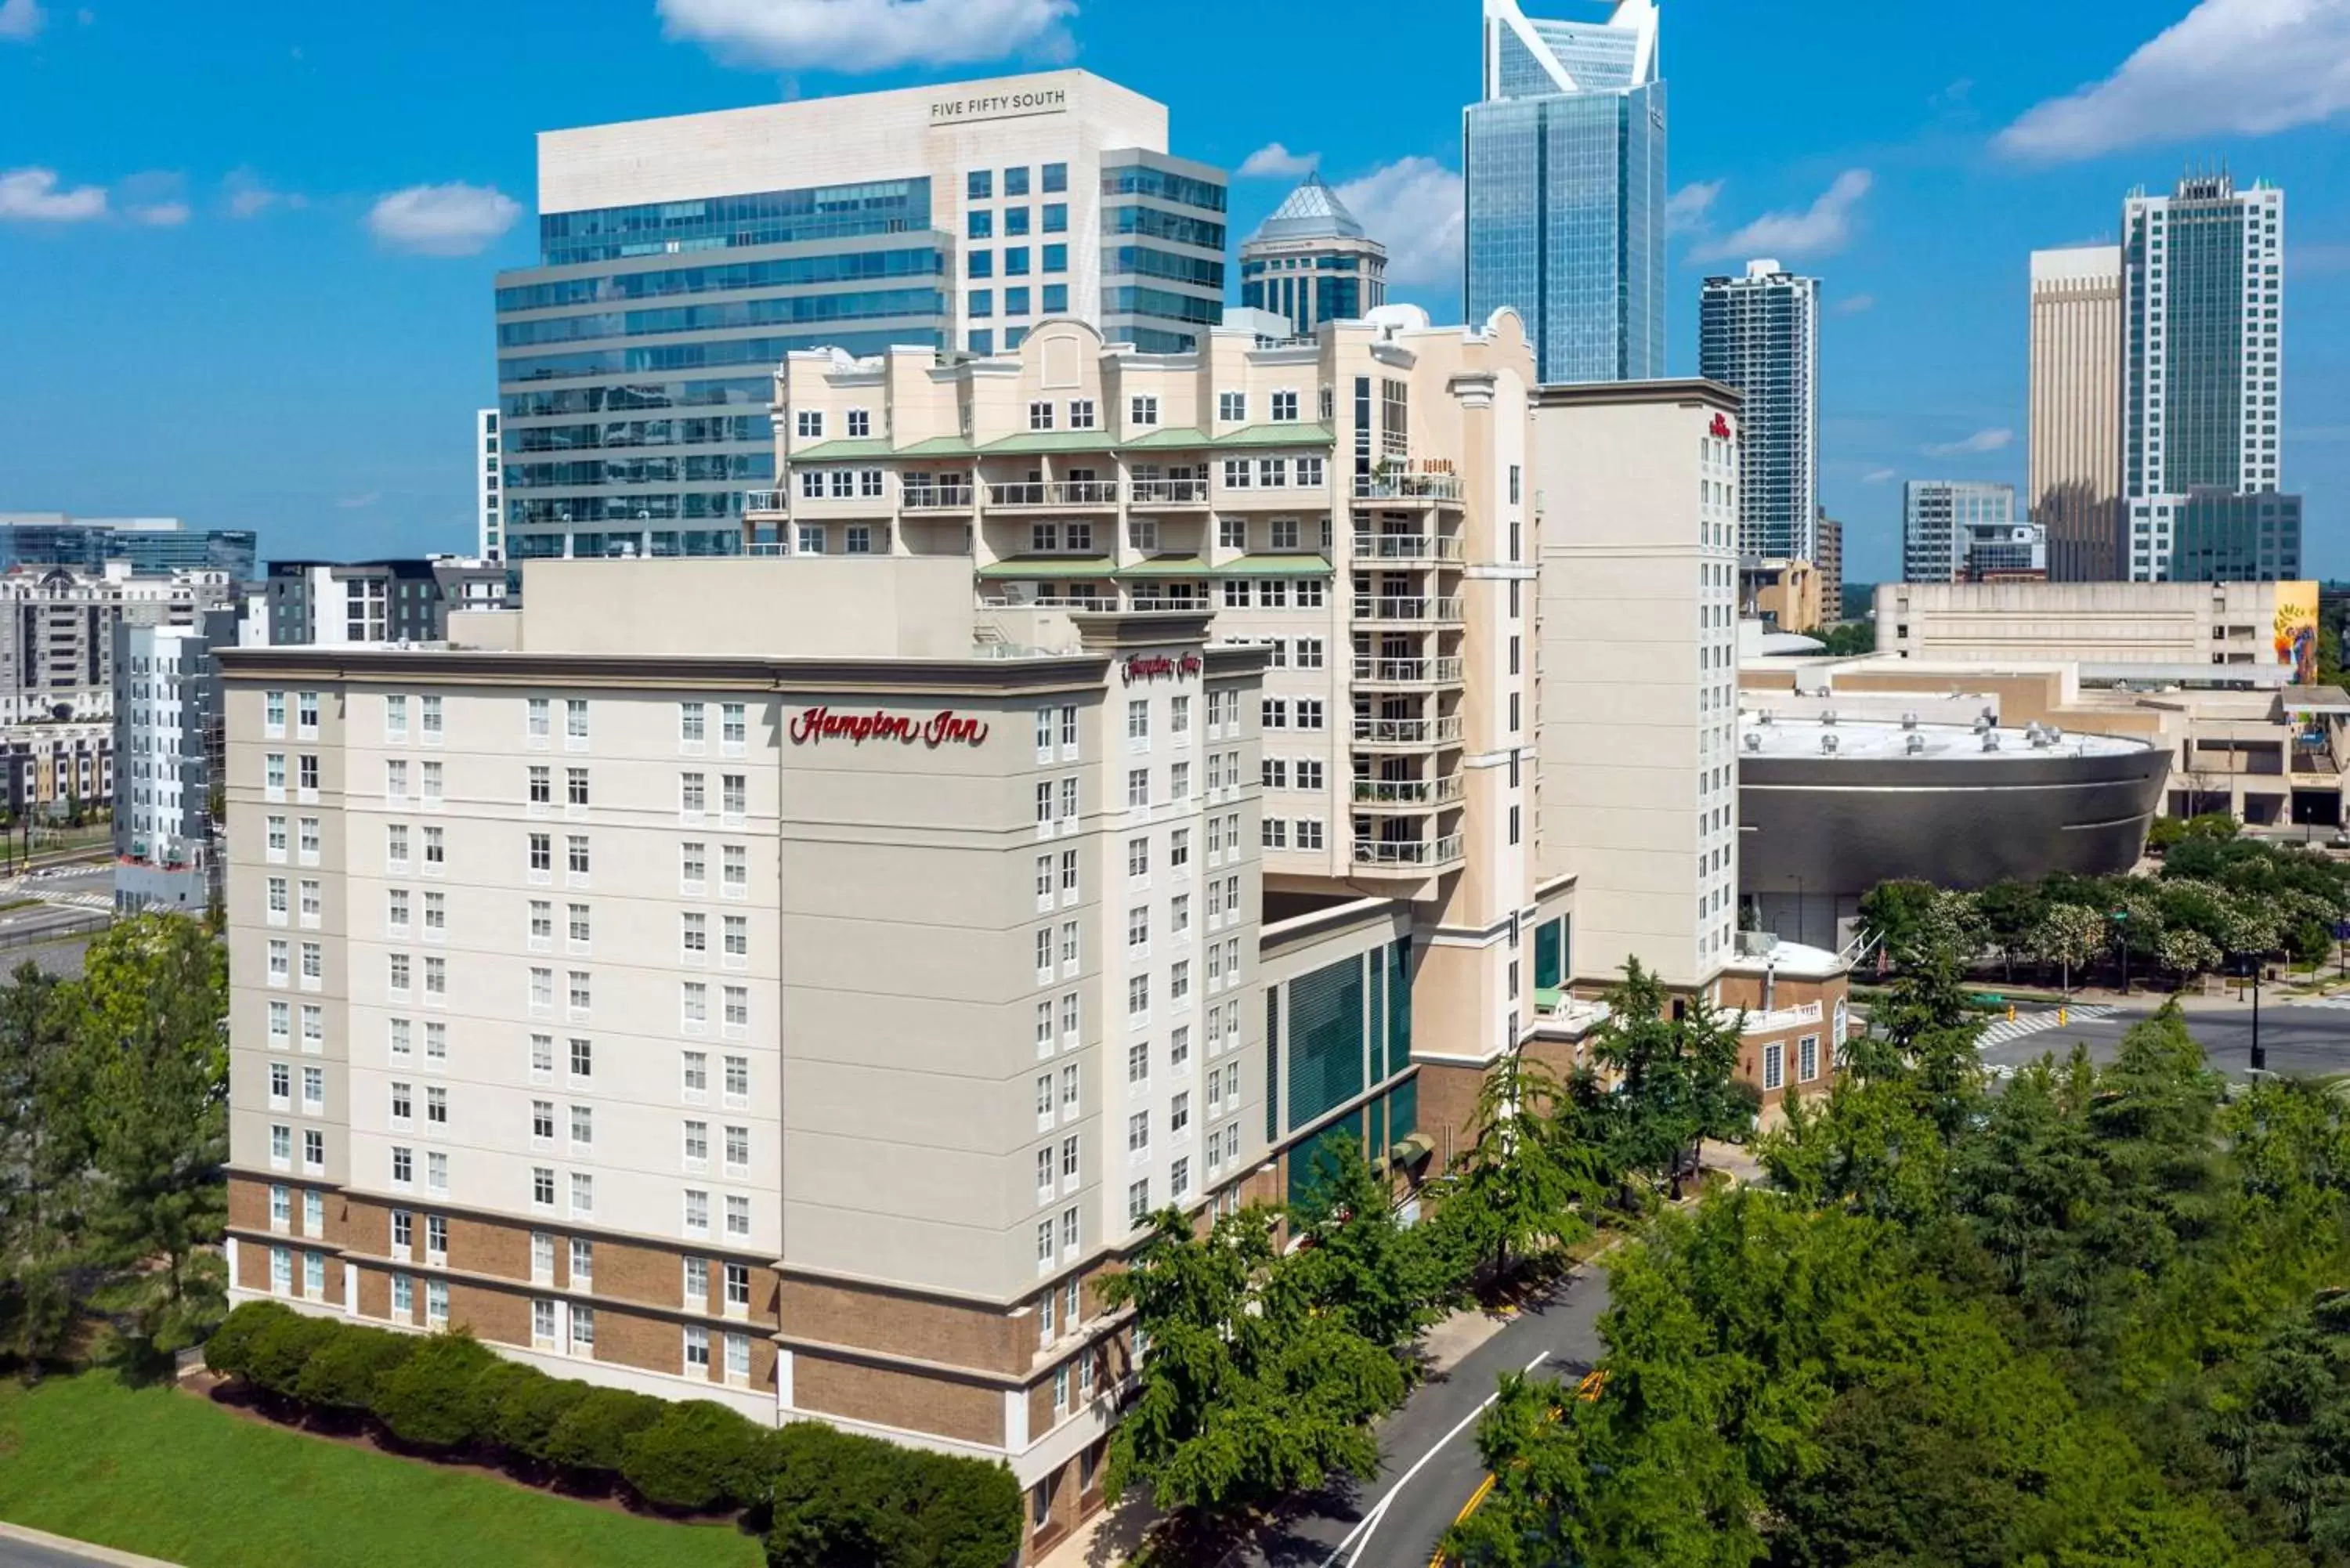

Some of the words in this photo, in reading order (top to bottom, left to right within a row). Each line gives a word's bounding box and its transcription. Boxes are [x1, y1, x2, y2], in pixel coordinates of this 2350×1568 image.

[931, 101, 963, 117] FIVE
[969, 96, 1008, 113] FIFTY
[1013, 90, 1065, 108] SOUTH
[790, 706, 920, 746] Hampton
[924, 710, 989, 749] Inn
